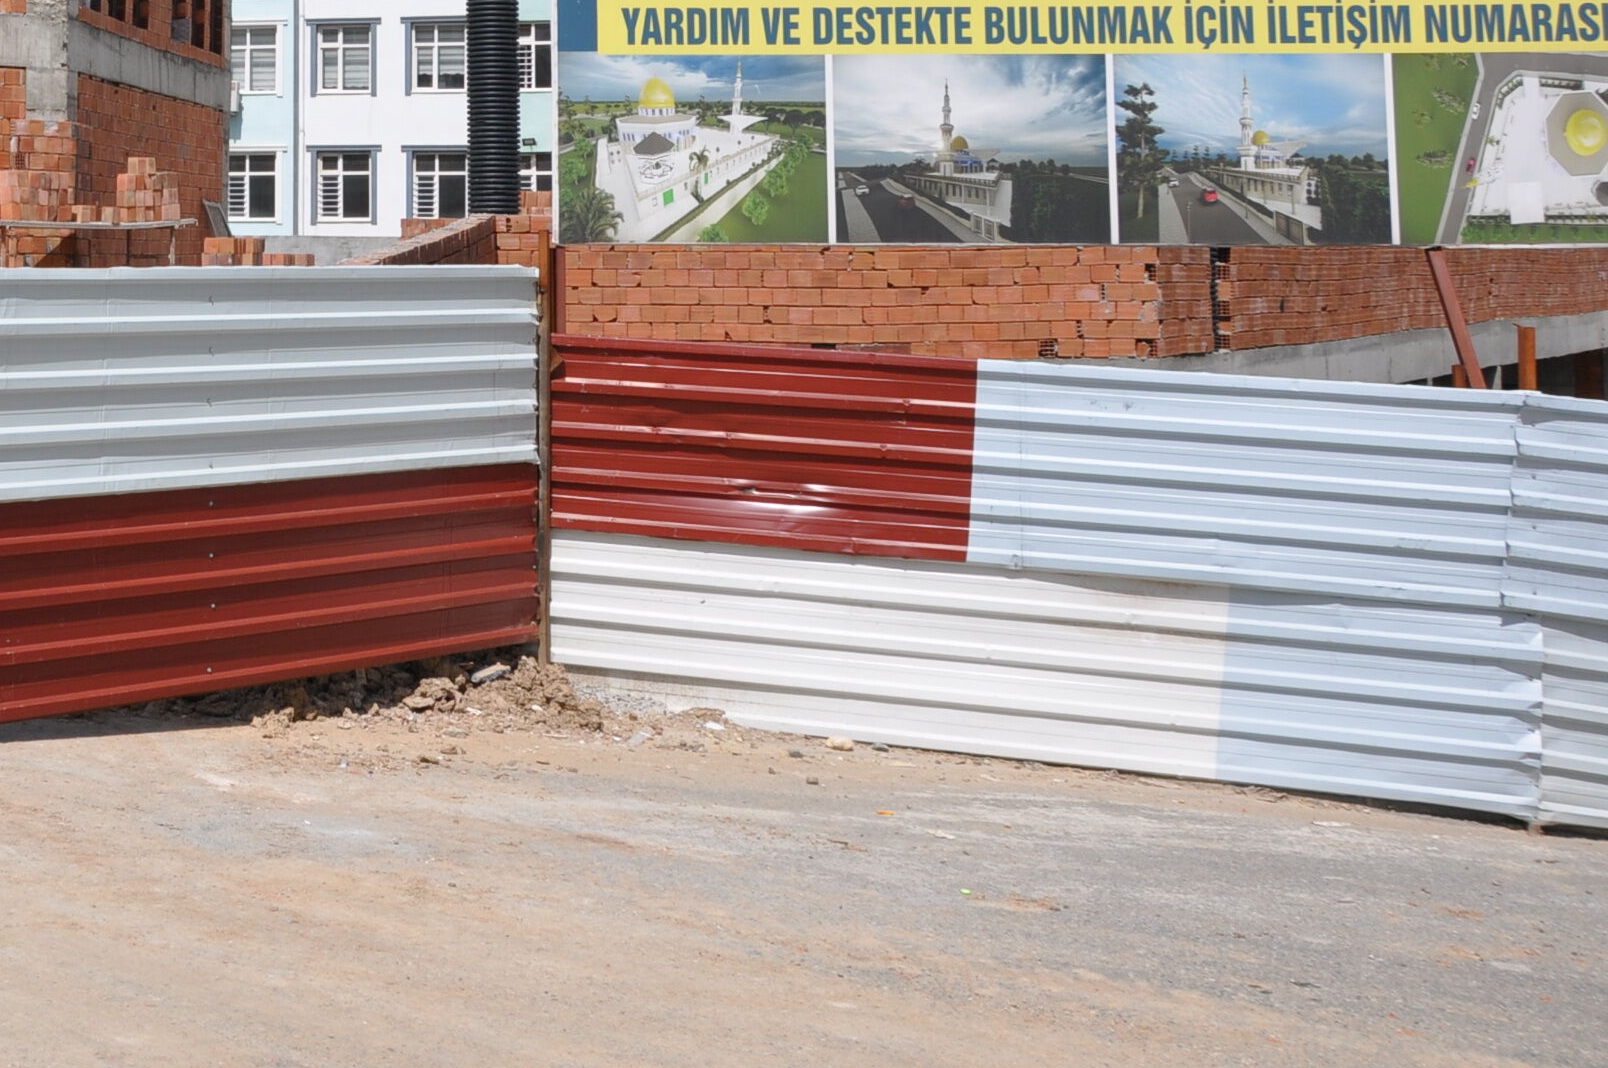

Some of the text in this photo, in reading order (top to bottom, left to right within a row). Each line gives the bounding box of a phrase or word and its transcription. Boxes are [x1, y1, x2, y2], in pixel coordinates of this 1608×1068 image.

[621, 7, 751, 46] YARDIM
[761, 7, 801, 46] VE
[812, 6, 974, 46] DESTEKTE
[984, 5, 1174, 45] BULUNMAK
[1424, 2, 1608, 44] NUMARASI
